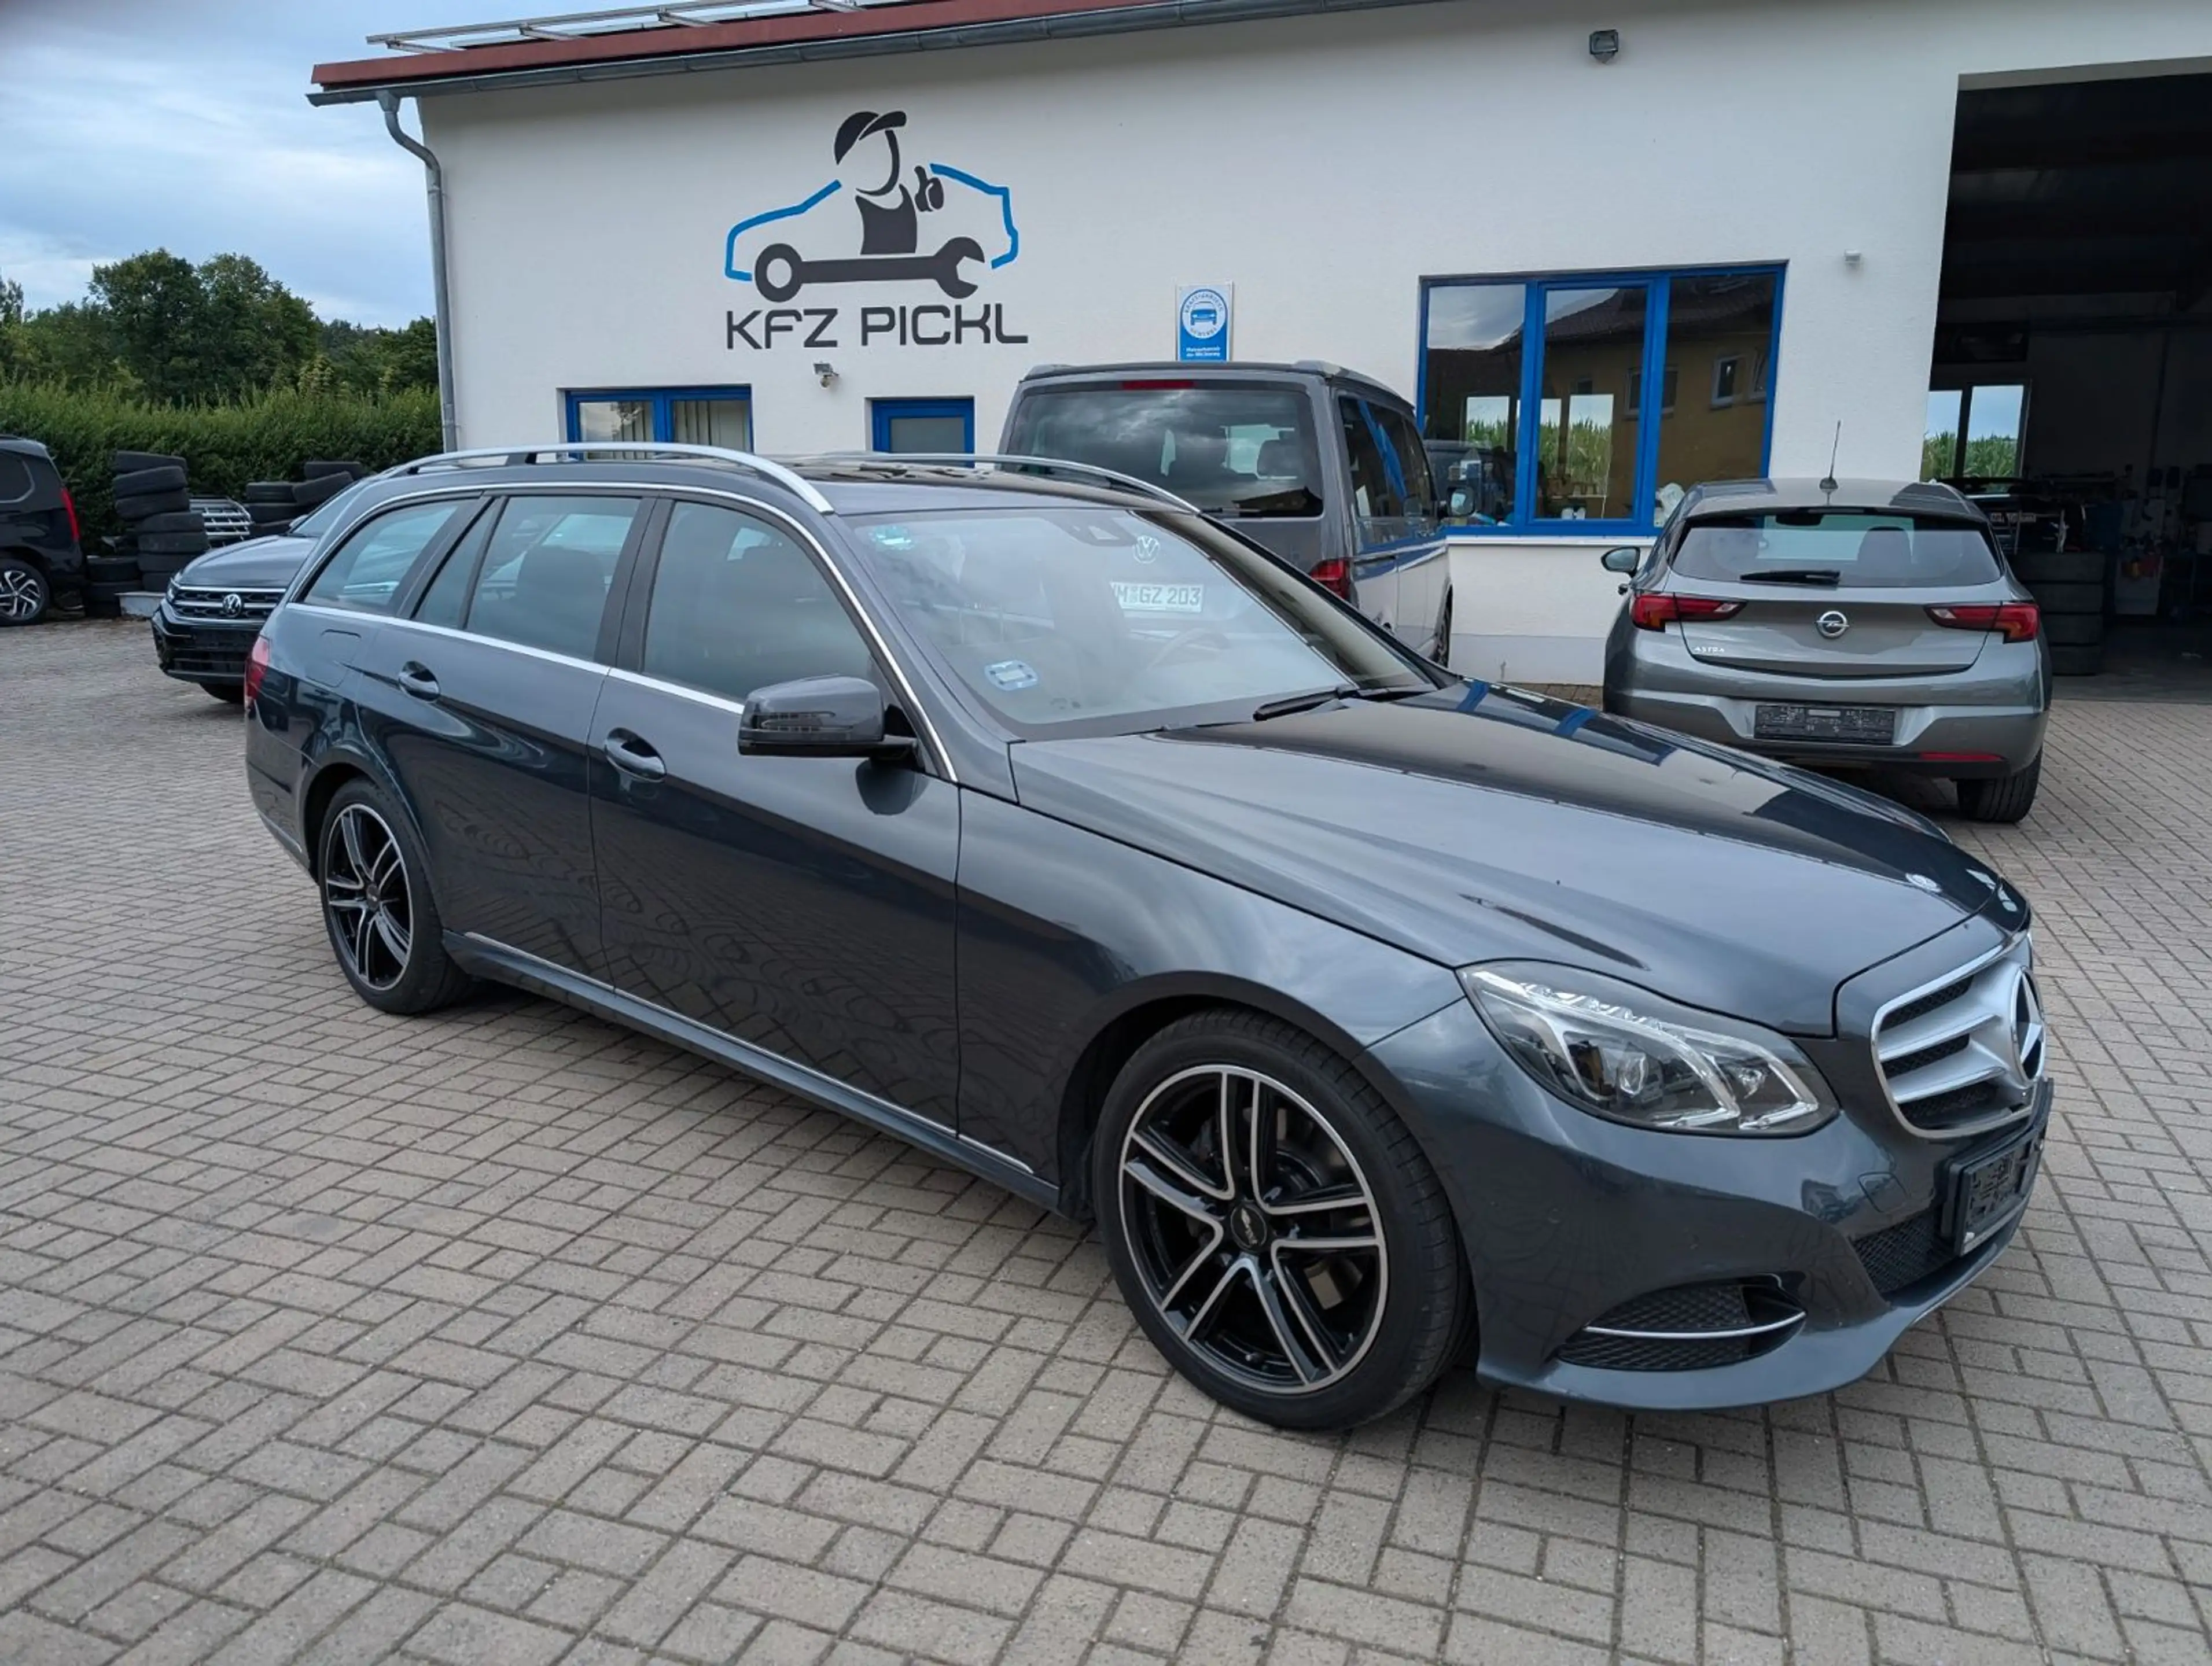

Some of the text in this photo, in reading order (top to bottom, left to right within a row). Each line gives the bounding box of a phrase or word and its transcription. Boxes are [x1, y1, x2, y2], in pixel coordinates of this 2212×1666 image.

[727, 303, 1028, 349] KFZ PICKL
[1139, 587, 1162, 604] GZ
[1166, 587, 1201, 606] 203
